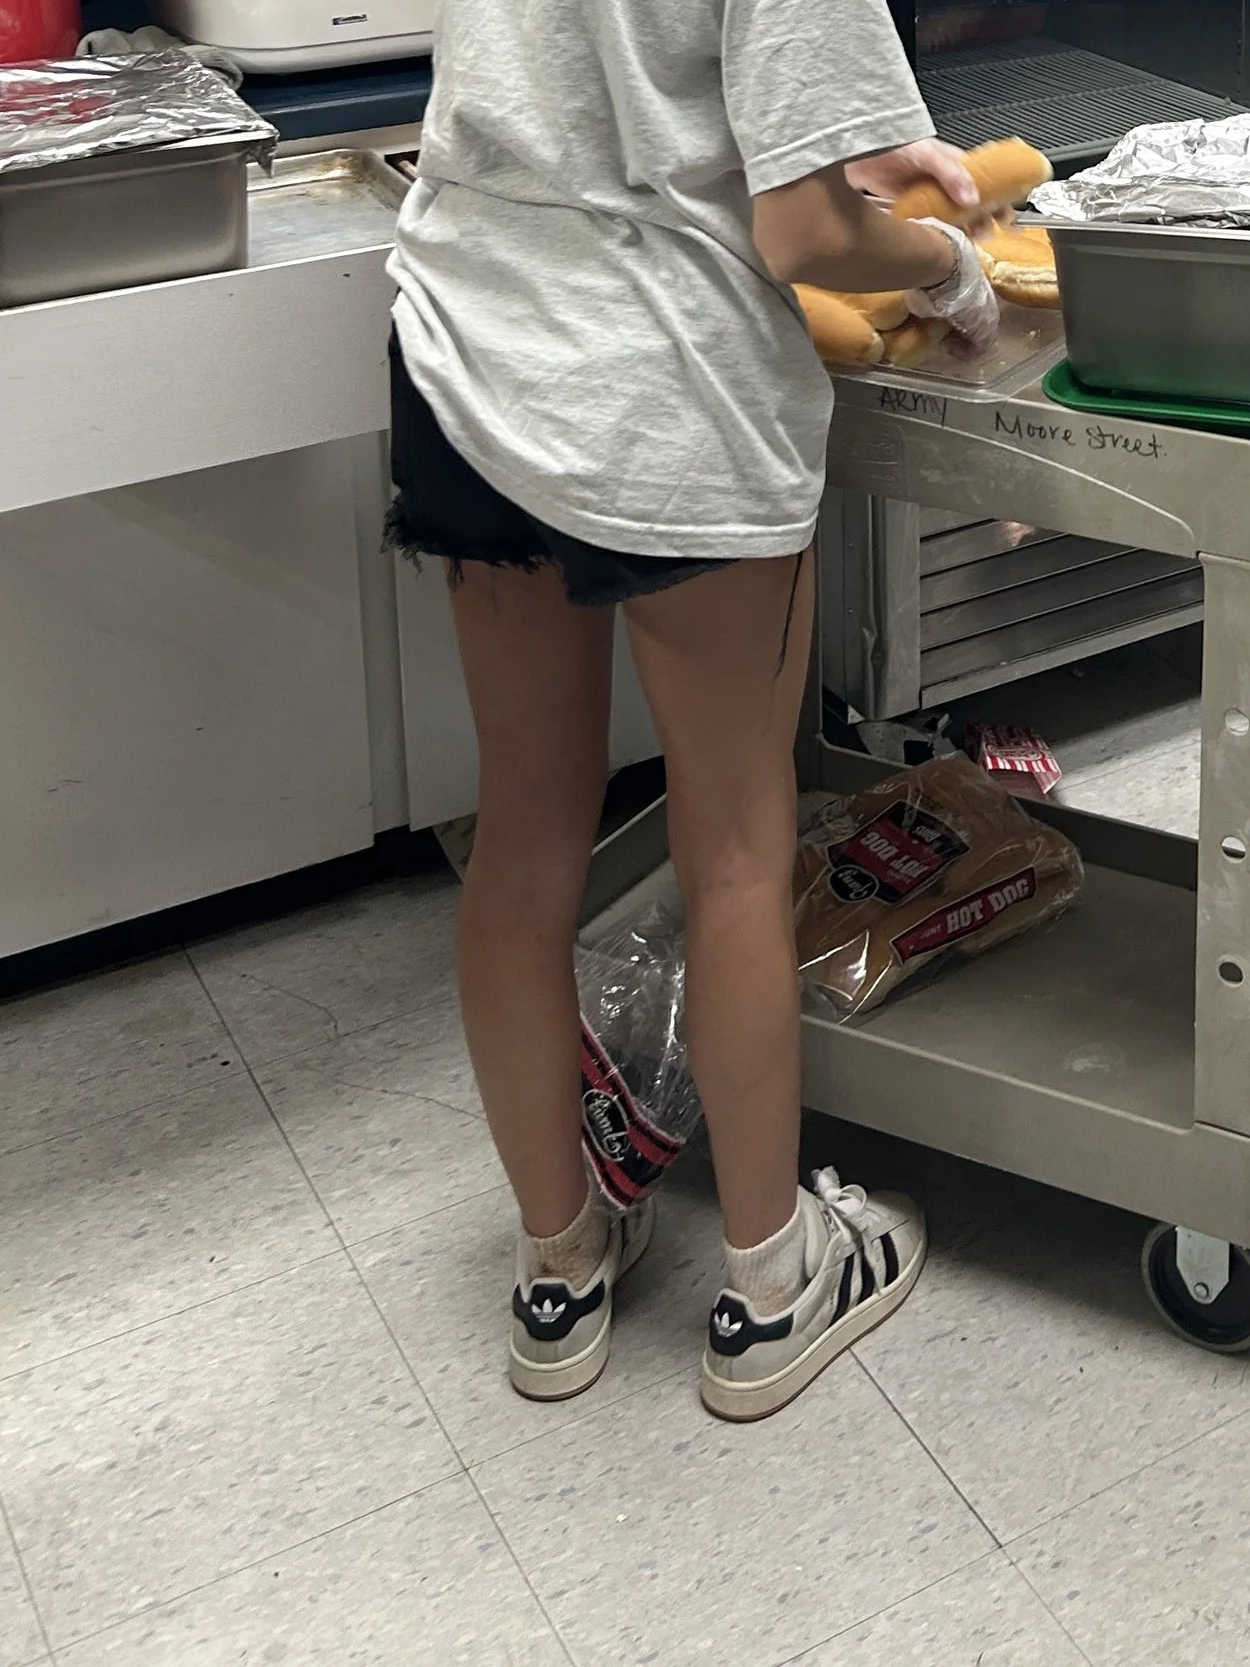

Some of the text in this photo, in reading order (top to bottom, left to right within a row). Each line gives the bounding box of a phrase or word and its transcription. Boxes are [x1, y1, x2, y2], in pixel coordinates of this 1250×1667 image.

[994, 410, 1077, 446] Moore
[859, 831, 900, 862] DOG
[889, 854, 929, 879] HOT
[945, 898, 984, 934] HOT
[987, 878, 1030, 913] DOG
